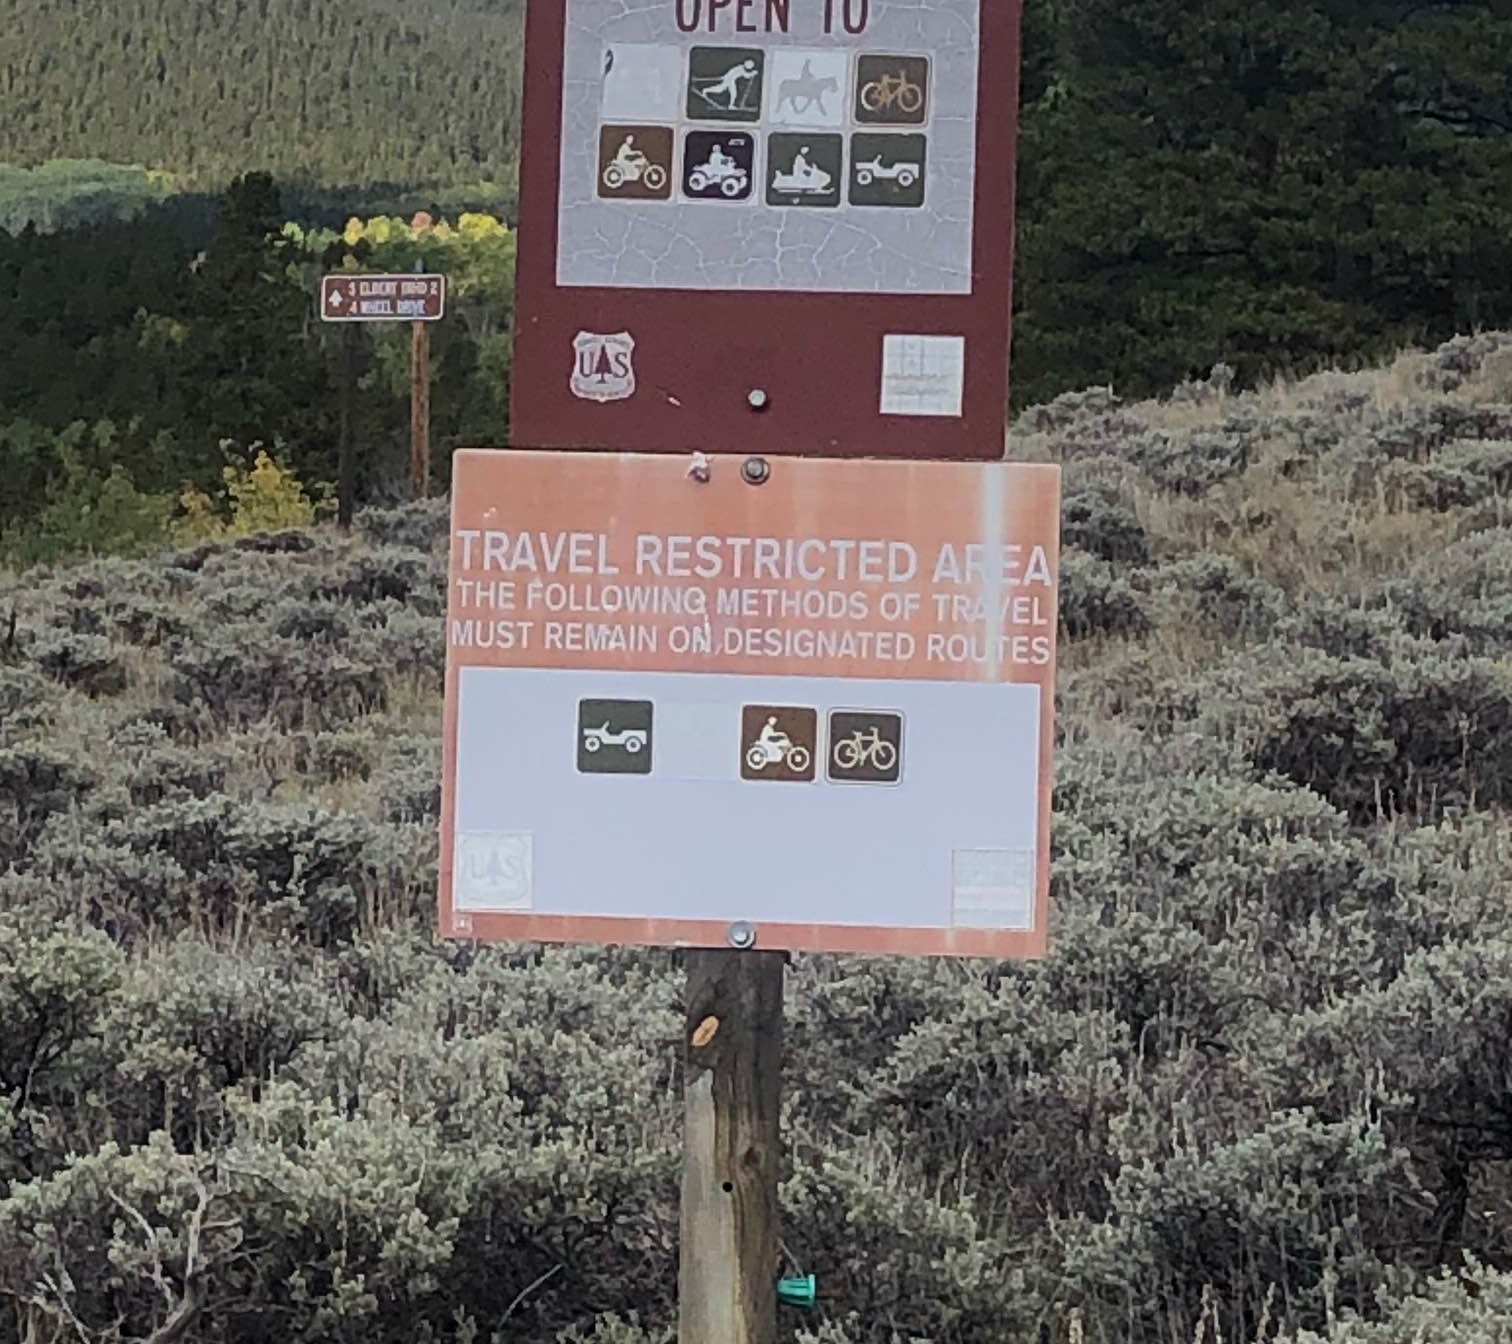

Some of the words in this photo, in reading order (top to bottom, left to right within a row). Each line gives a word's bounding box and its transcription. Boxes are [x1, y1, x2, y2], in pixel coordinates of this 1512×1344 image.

[455, 529, 620, 575] TRAVEL
[635, 534, 918, 583] RESTRICTED
[931, 543, 1053, 587] AREA
[455, 578, 516, 610] THE
[526, 579, 707, 615] FOLLOWING
[716, 587, 869, 621] METHODS
[879, 592, 921, 622] OF
[451, 620, 535, 649] MUST
[544, 622, 657, 653] REMAIN
[668, 625, 712, 654] ON
[723, 627, 916, 661] DESIGNATED
[927, 633, 1050, 665] ROUTES
